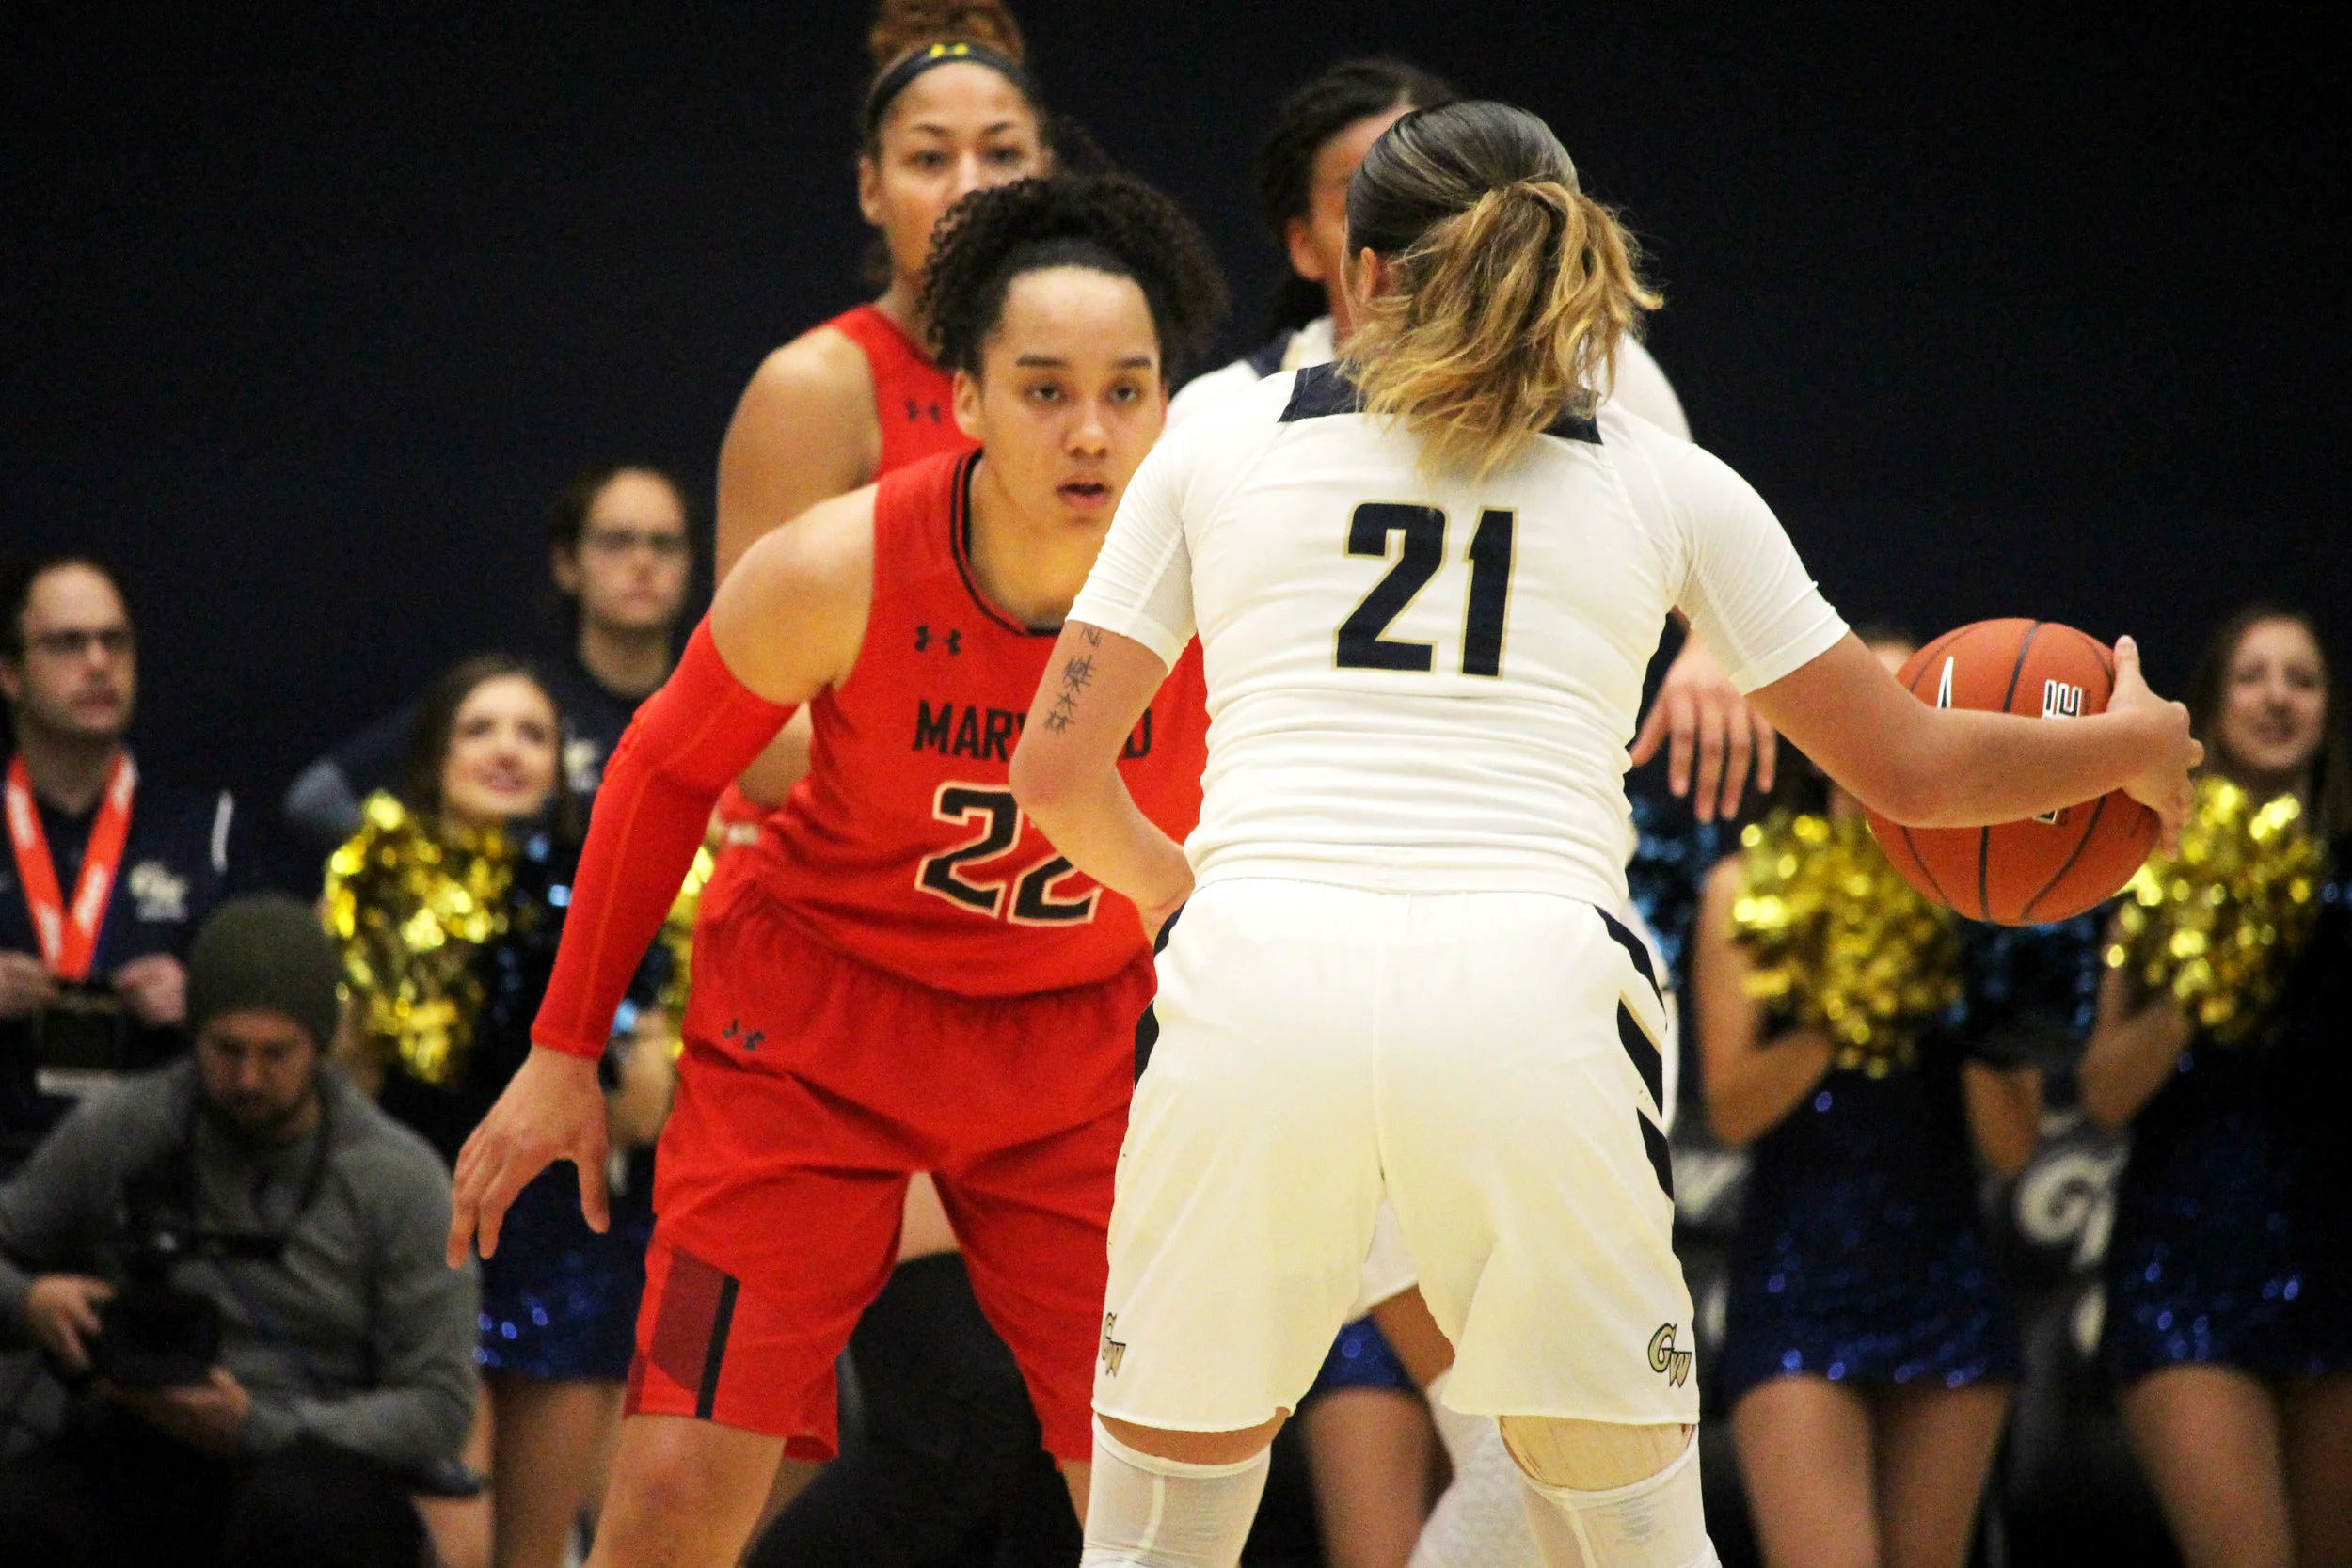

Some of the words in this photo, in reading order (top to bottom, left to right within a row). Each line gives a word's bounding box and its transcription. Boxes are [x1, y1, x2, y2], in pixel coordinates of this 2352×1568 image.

[1331, 499, 1518, 680] 21
[912, 699, 1152, 762] MARD
[914, 780, 1104, 927] 22
[1647, 1323, 1692, 1388] GW
